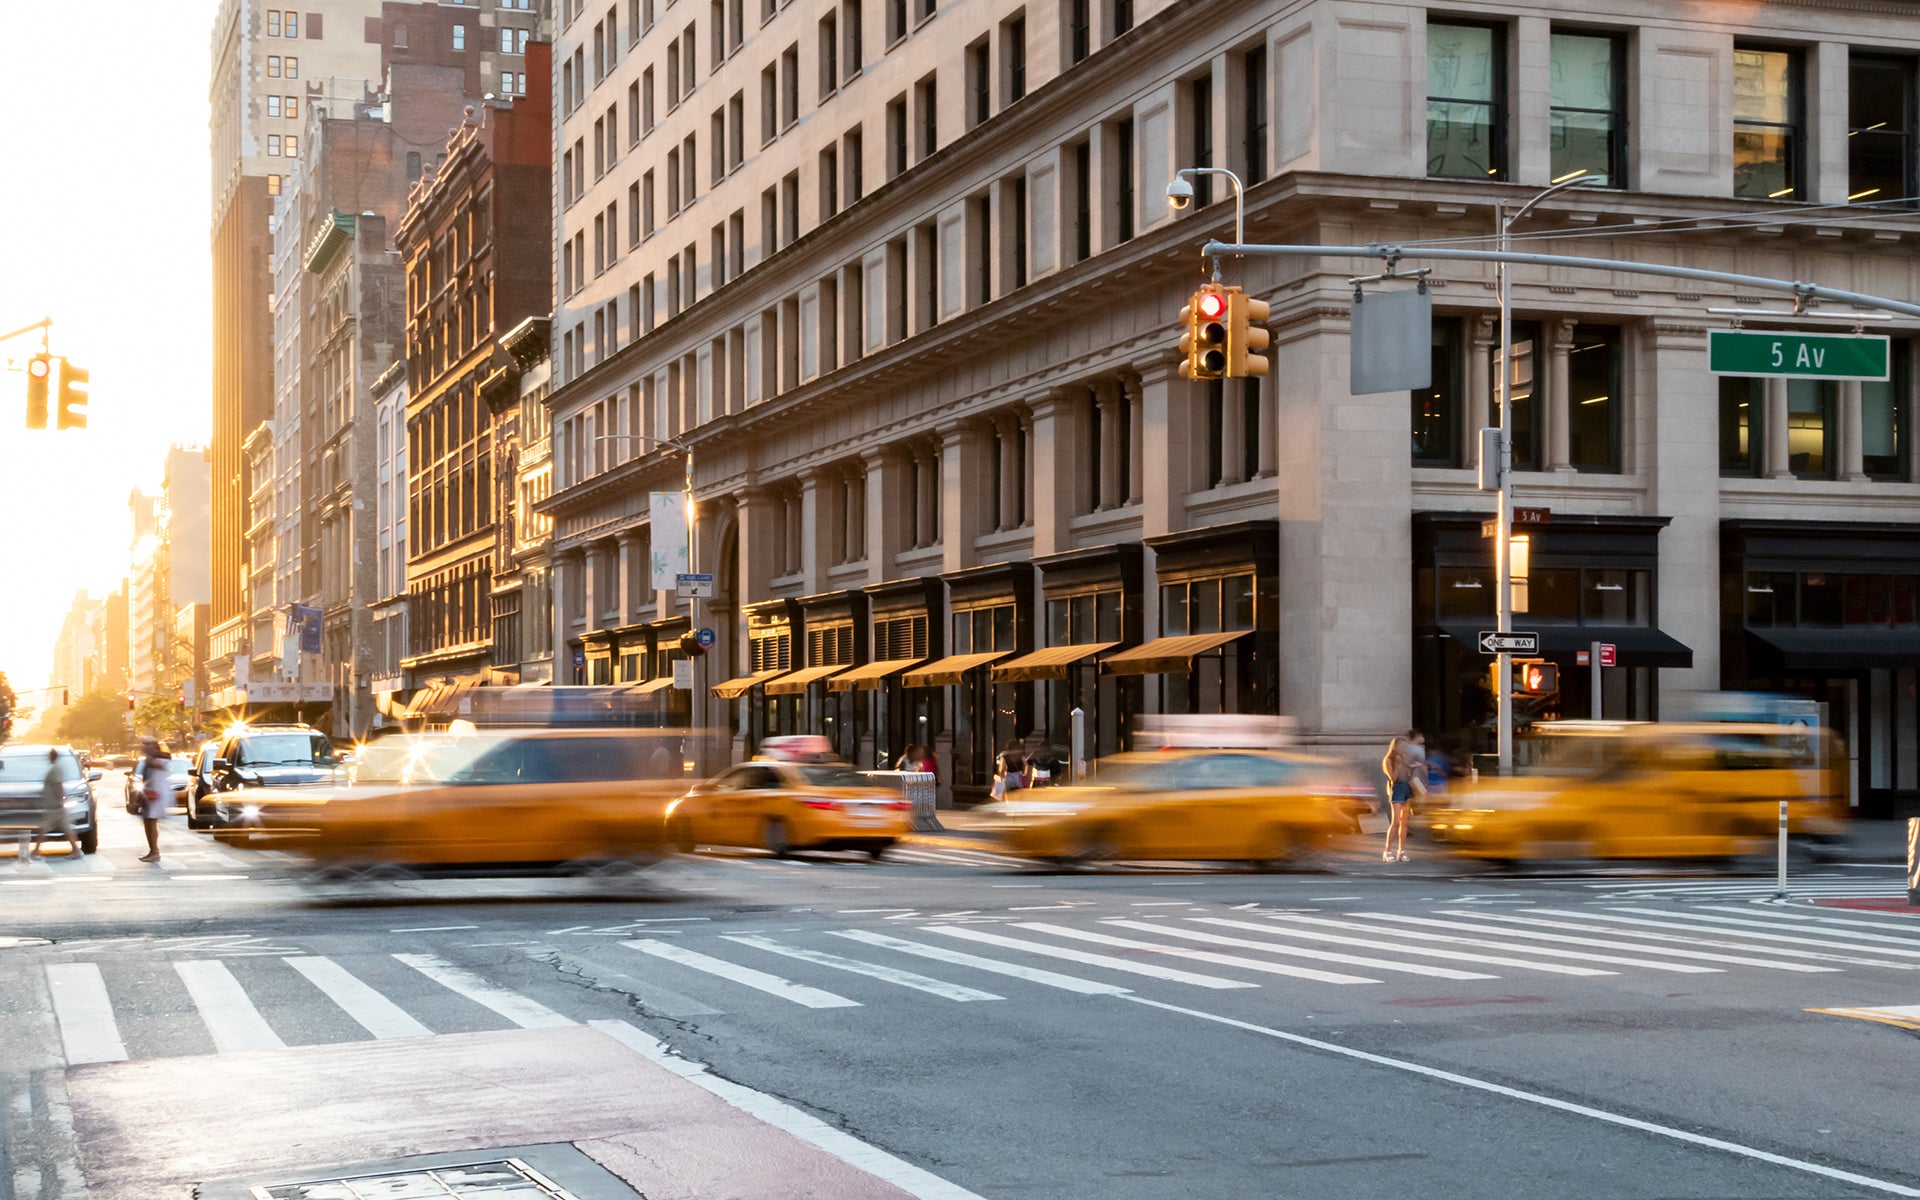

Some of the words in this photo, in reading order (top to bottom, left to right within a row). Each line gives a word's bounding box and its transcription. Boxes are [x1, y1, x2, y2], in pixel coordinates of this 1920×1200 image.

[1771, 342, 1783, 367] 5
[1795, 343, 1825, 368] Av
[1522, 511, 1528, 521] 5
[1530, 511, 1542, 522] Av
[1487, 638, 1505, 647] ONE
[1514, 639, 1533, 647] WAY
